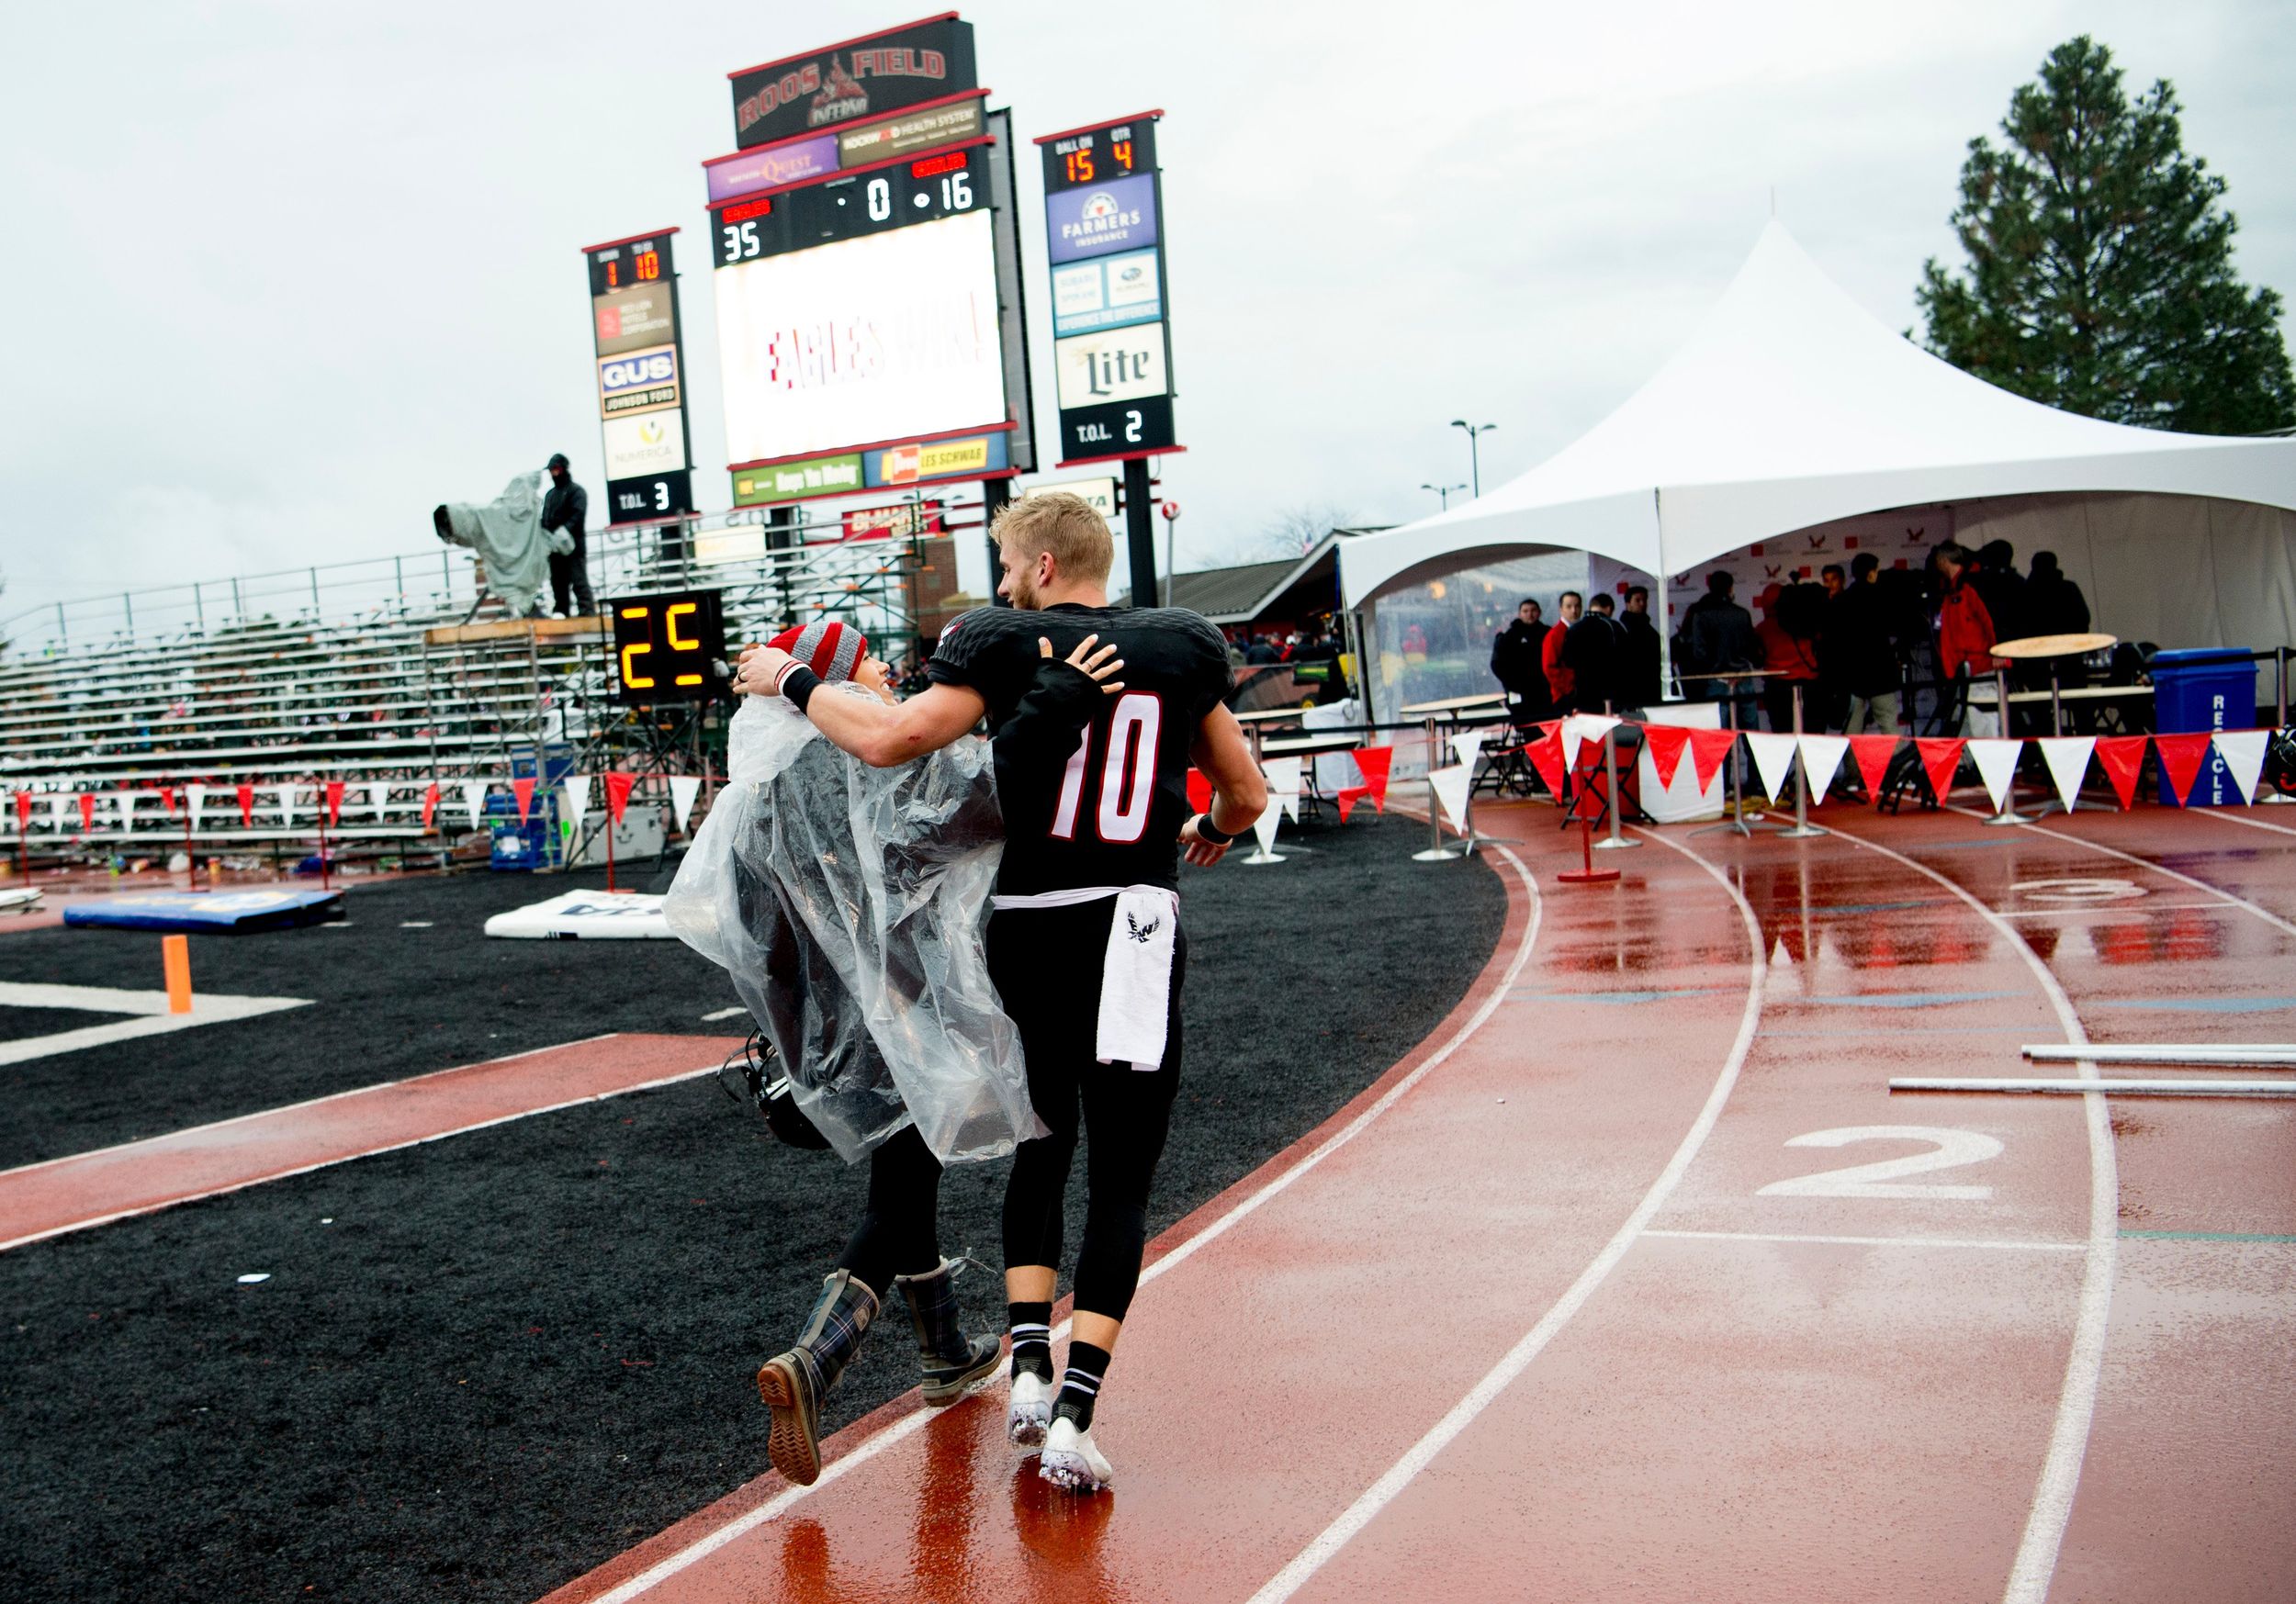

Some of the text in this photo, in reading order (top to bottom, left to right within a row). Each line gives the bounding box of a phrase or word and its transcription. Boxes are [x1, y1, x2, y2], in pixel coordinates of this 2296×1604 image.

[737, 49, 946, 132] ROOS FIELD
[901, 117, 938, 136] HEALTH
[938, 107, 975, 127] SYSTEM
[1066, 148, 1095, 183] 15
[1113, 140, 1132, 170] 4
[867, 178, 891, 221] 0
[941, 172, 973, 210] 16
[1062, 209, 1142, 239] FARMERS
[1075, 230, 1129, 248] INSURANCE
[724, 221, 760, 261] 35
[607, 261, 617, 286] 1
[636, 250, 659, 280] 10
[602, 355, 673, 388] GUS
[1086, 350, 1150, 397] Lite
[606, 387, 674, 411] JOHNSON FORD
[1076, 423, 1112, 443] T.O.L.
[1125, 410, 1142, 442] 2
[920, 454, 936, 466] LES
[939, 449, 982, 465] SCHWAB
[654, 482, 670, 510] 3
[1047, 690, 1163, 845] 10
[2009, 878, 2149, 903] 3
[1754, 1125, 2005, 1200] 2
